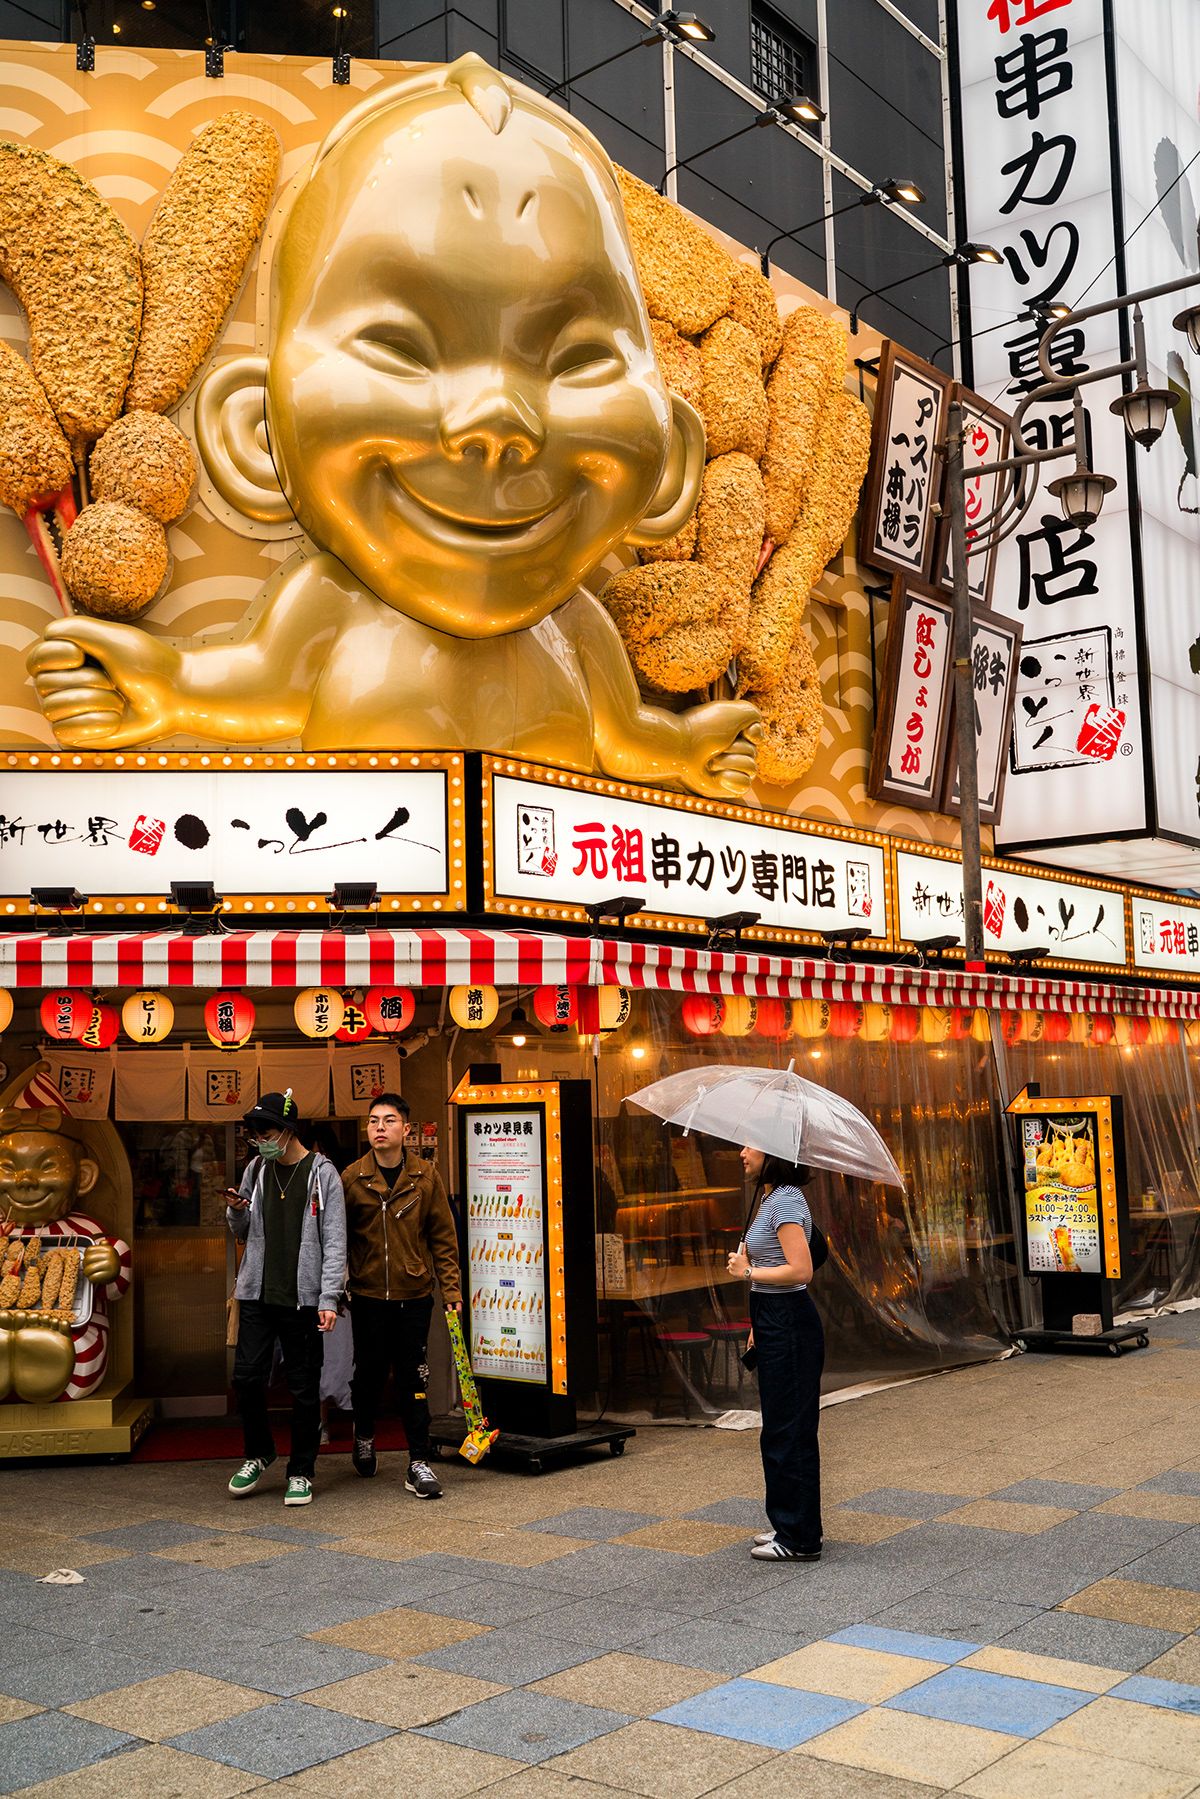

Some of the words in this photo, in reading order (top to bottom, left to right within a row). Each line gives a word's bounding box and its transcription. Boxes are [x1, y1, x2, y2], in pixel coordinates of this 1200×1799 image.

[903, 397, 934, 549] アスパラ
[900, 613, 936, 774] 紅しょうが
[1160, 920, 1199, 957] 元祖串
[57, 996, 72, 1034] いっとく
[142, 999, 156, 1036] ビール
[217, 1001, 234, 1033] 元祖
[315, 993, 329, 1033] ホルモン
[342, 1007, 364, 1033] 牛
[380, 996, 403, 1019] 酒
[468, 989, 483, 1021] 焼酎
[474, 1120, 533, 1136] 串カツ早見表
